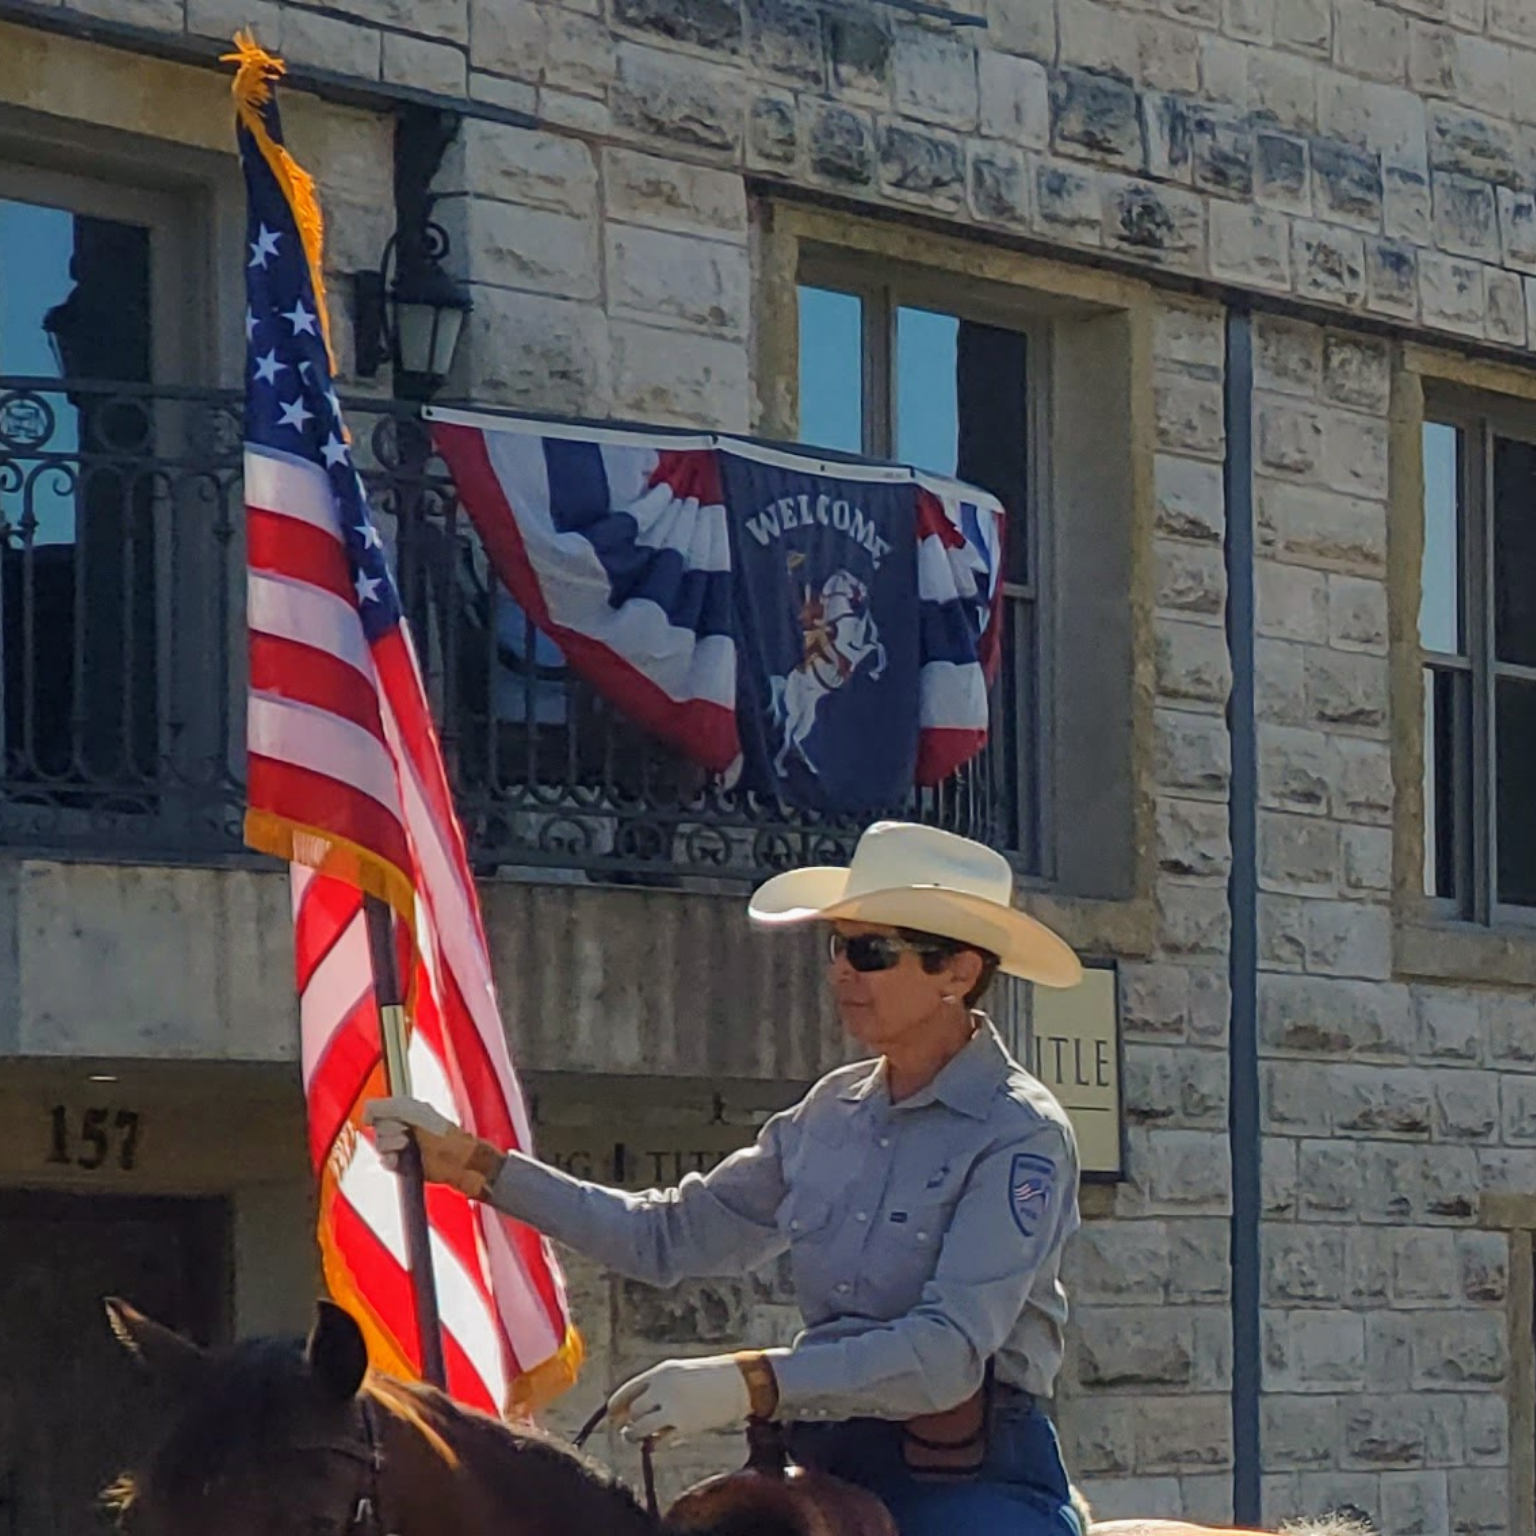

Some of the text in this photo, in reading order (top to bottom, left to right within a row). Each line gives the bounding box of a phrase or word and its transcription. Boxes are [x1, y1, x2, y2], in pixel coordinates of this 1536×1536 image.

[745, 494, 892, 570] WELCOME
[1035, 1036, 1110, 1087] ITLE
[44, 1105, 139, 1171] 157
